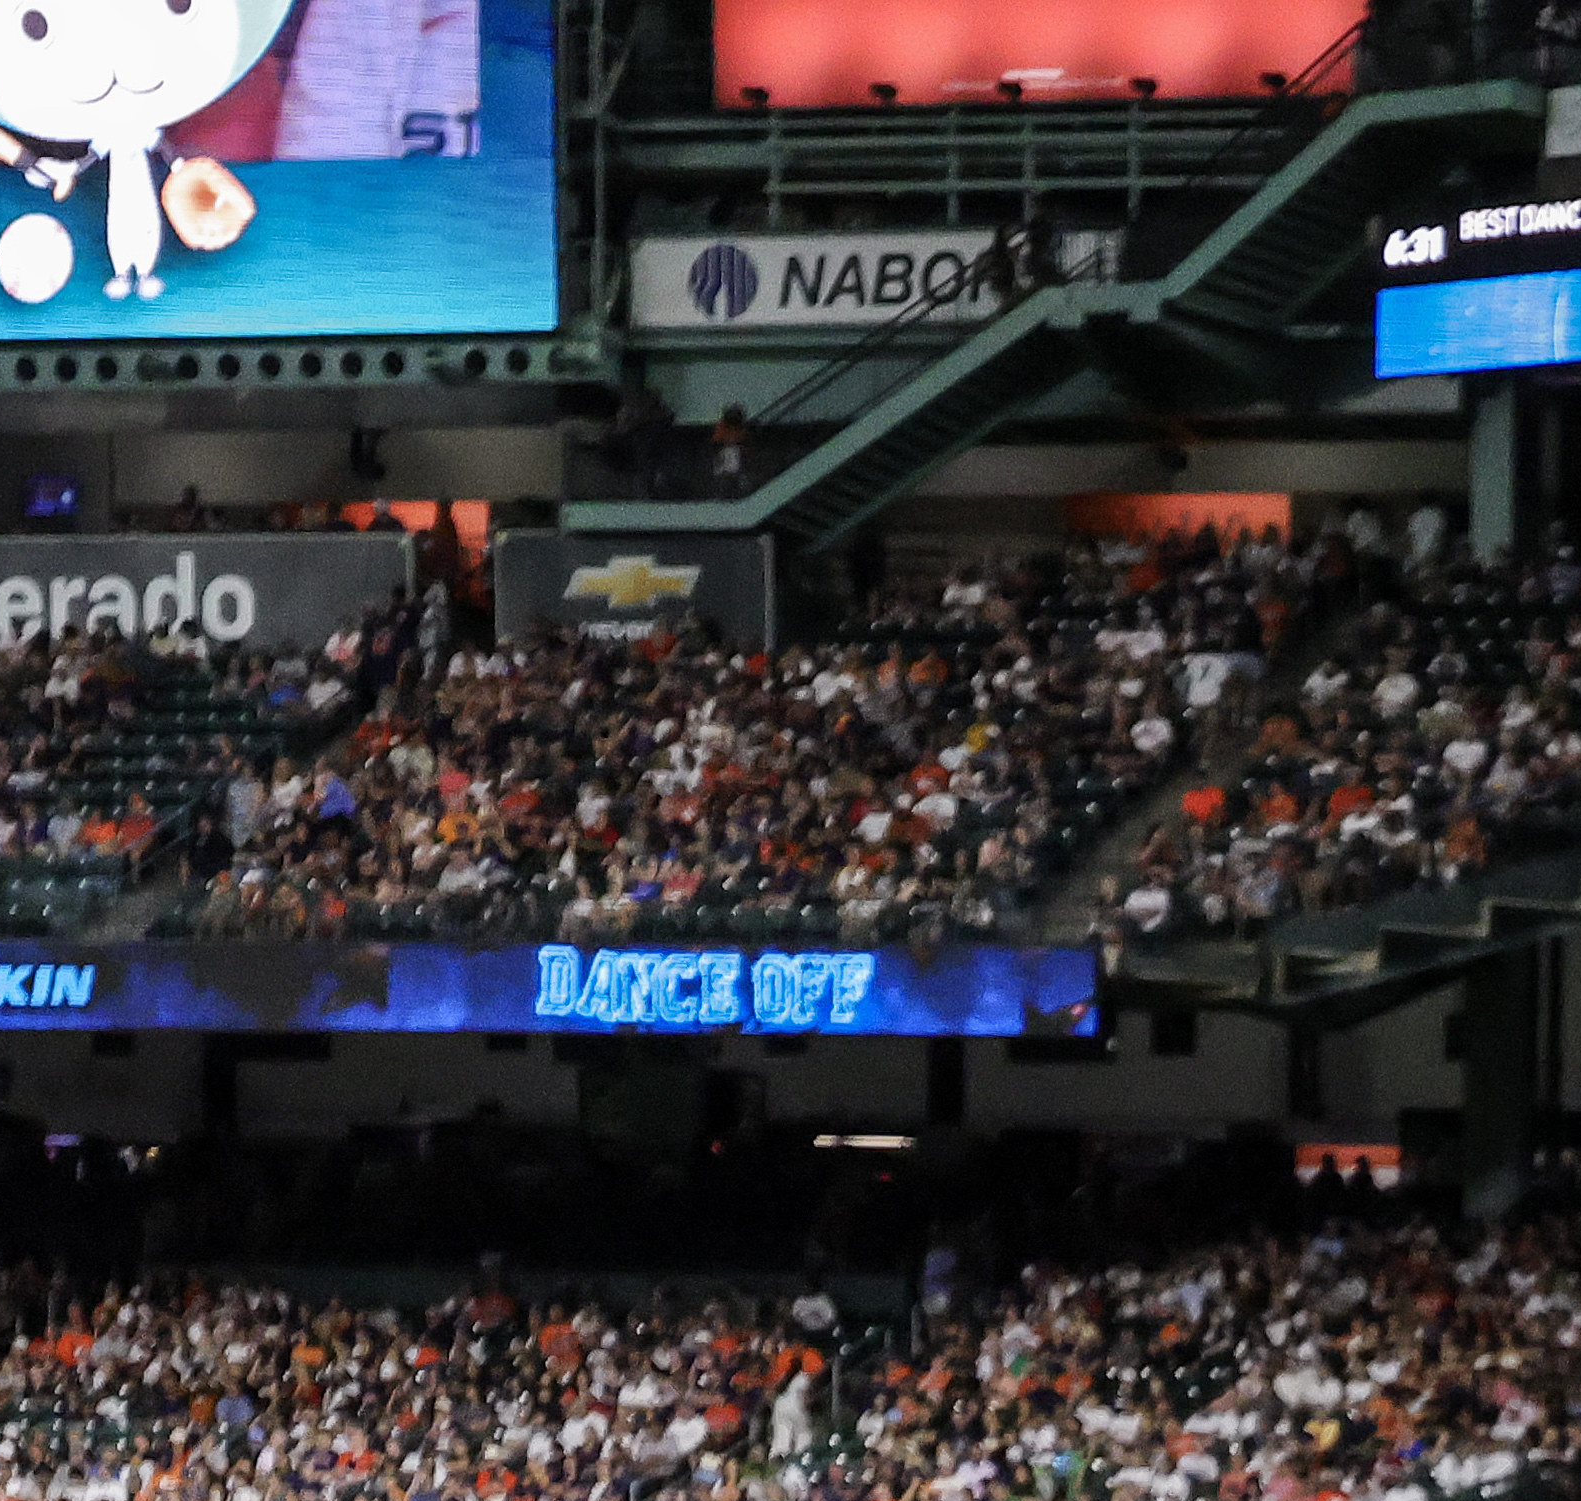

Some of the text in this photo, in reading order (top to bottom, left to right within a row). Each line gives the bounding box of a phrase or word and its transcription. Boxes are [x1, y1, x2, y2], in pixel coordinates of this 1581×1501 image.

[1460, 206, 1519, 240] BEST
[535, 944, 875, 1024] DANCE OFF
